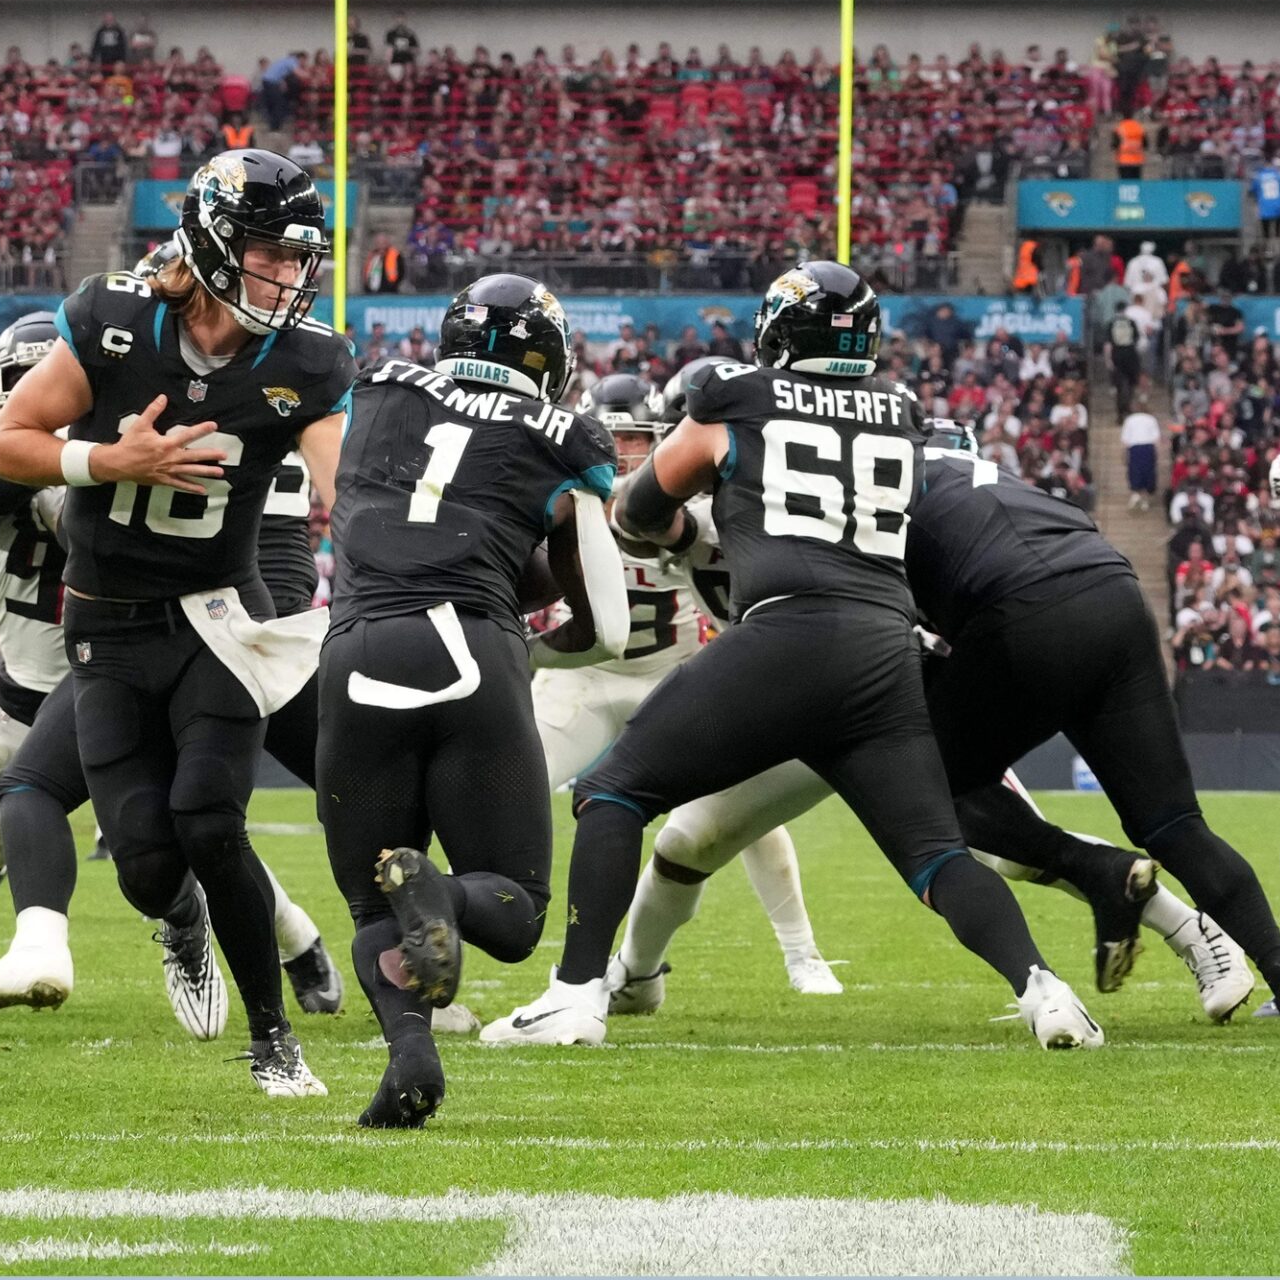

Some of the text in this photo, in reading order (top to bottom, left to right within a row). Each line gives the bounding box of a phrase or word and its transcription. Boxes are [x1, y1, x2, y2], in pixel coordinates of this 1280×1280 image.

[101, 326, 134, 355] C
[487, 328, 498, 352] 1
[838, 333, 867, 354] 68
[451, 361, 511, 385] JAGUARS
[824, 359, 869, 375] JAGUARS
[372, 359, 575, 446] ETIENNE JR
[772, 378, 903, 426] SCHERFF
[407, 422, 474, 523] 1
[761, 420, 915, 560] 68
